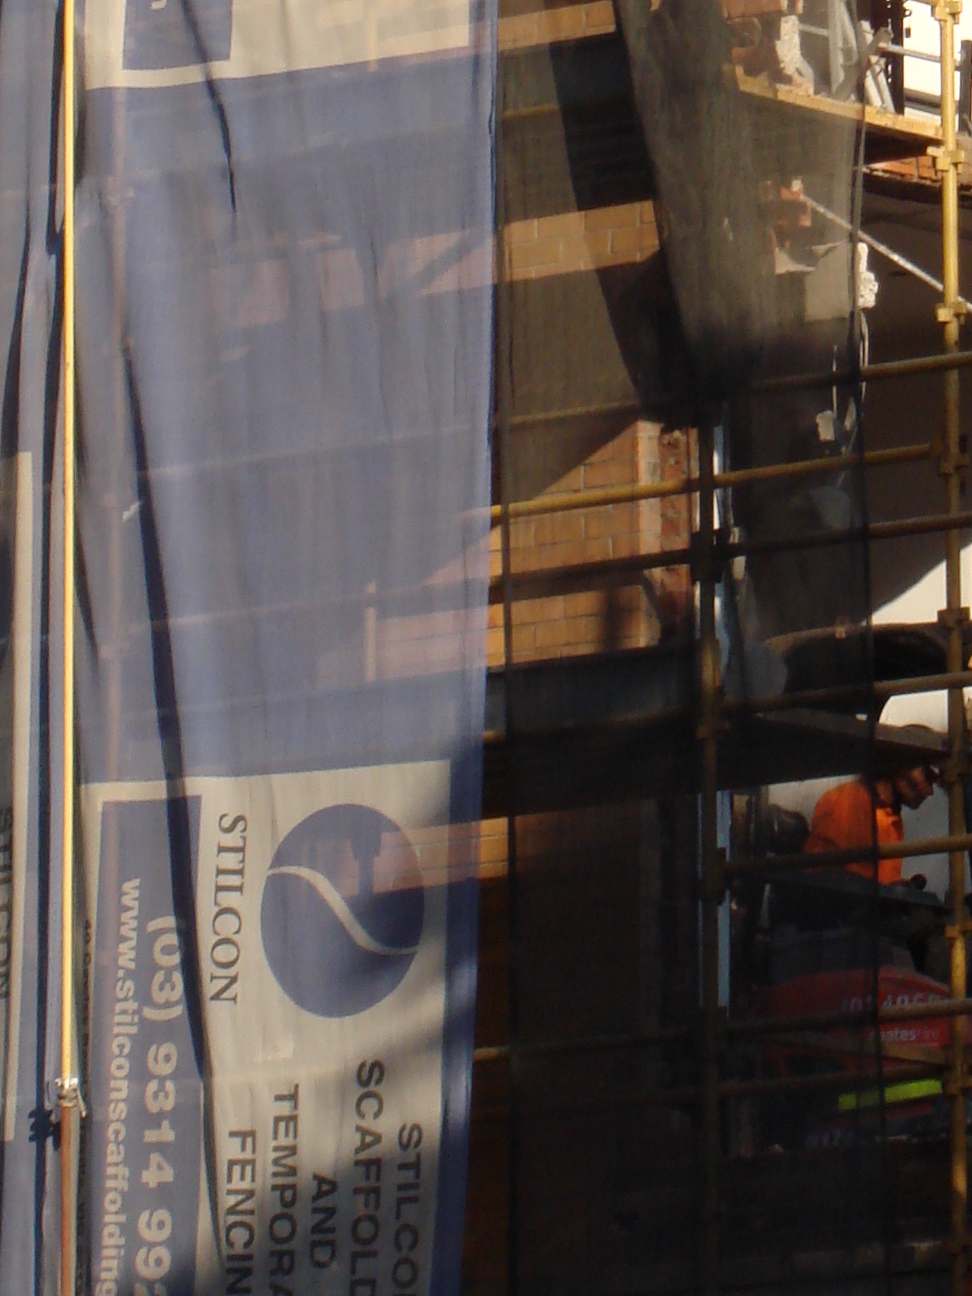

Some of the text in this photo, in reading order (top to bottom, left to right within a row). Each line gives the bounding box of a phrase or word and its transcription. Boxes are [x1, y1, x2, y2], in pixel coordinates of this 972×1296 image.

[143, 915, 185, 1021] (03)
[210, 813, 247, 1005] STILCON
[140, 1042, 178, 1189] 9314
[310, 1174, 337, 1269] AND
[391, 1123, 423, 1296] STILCO
